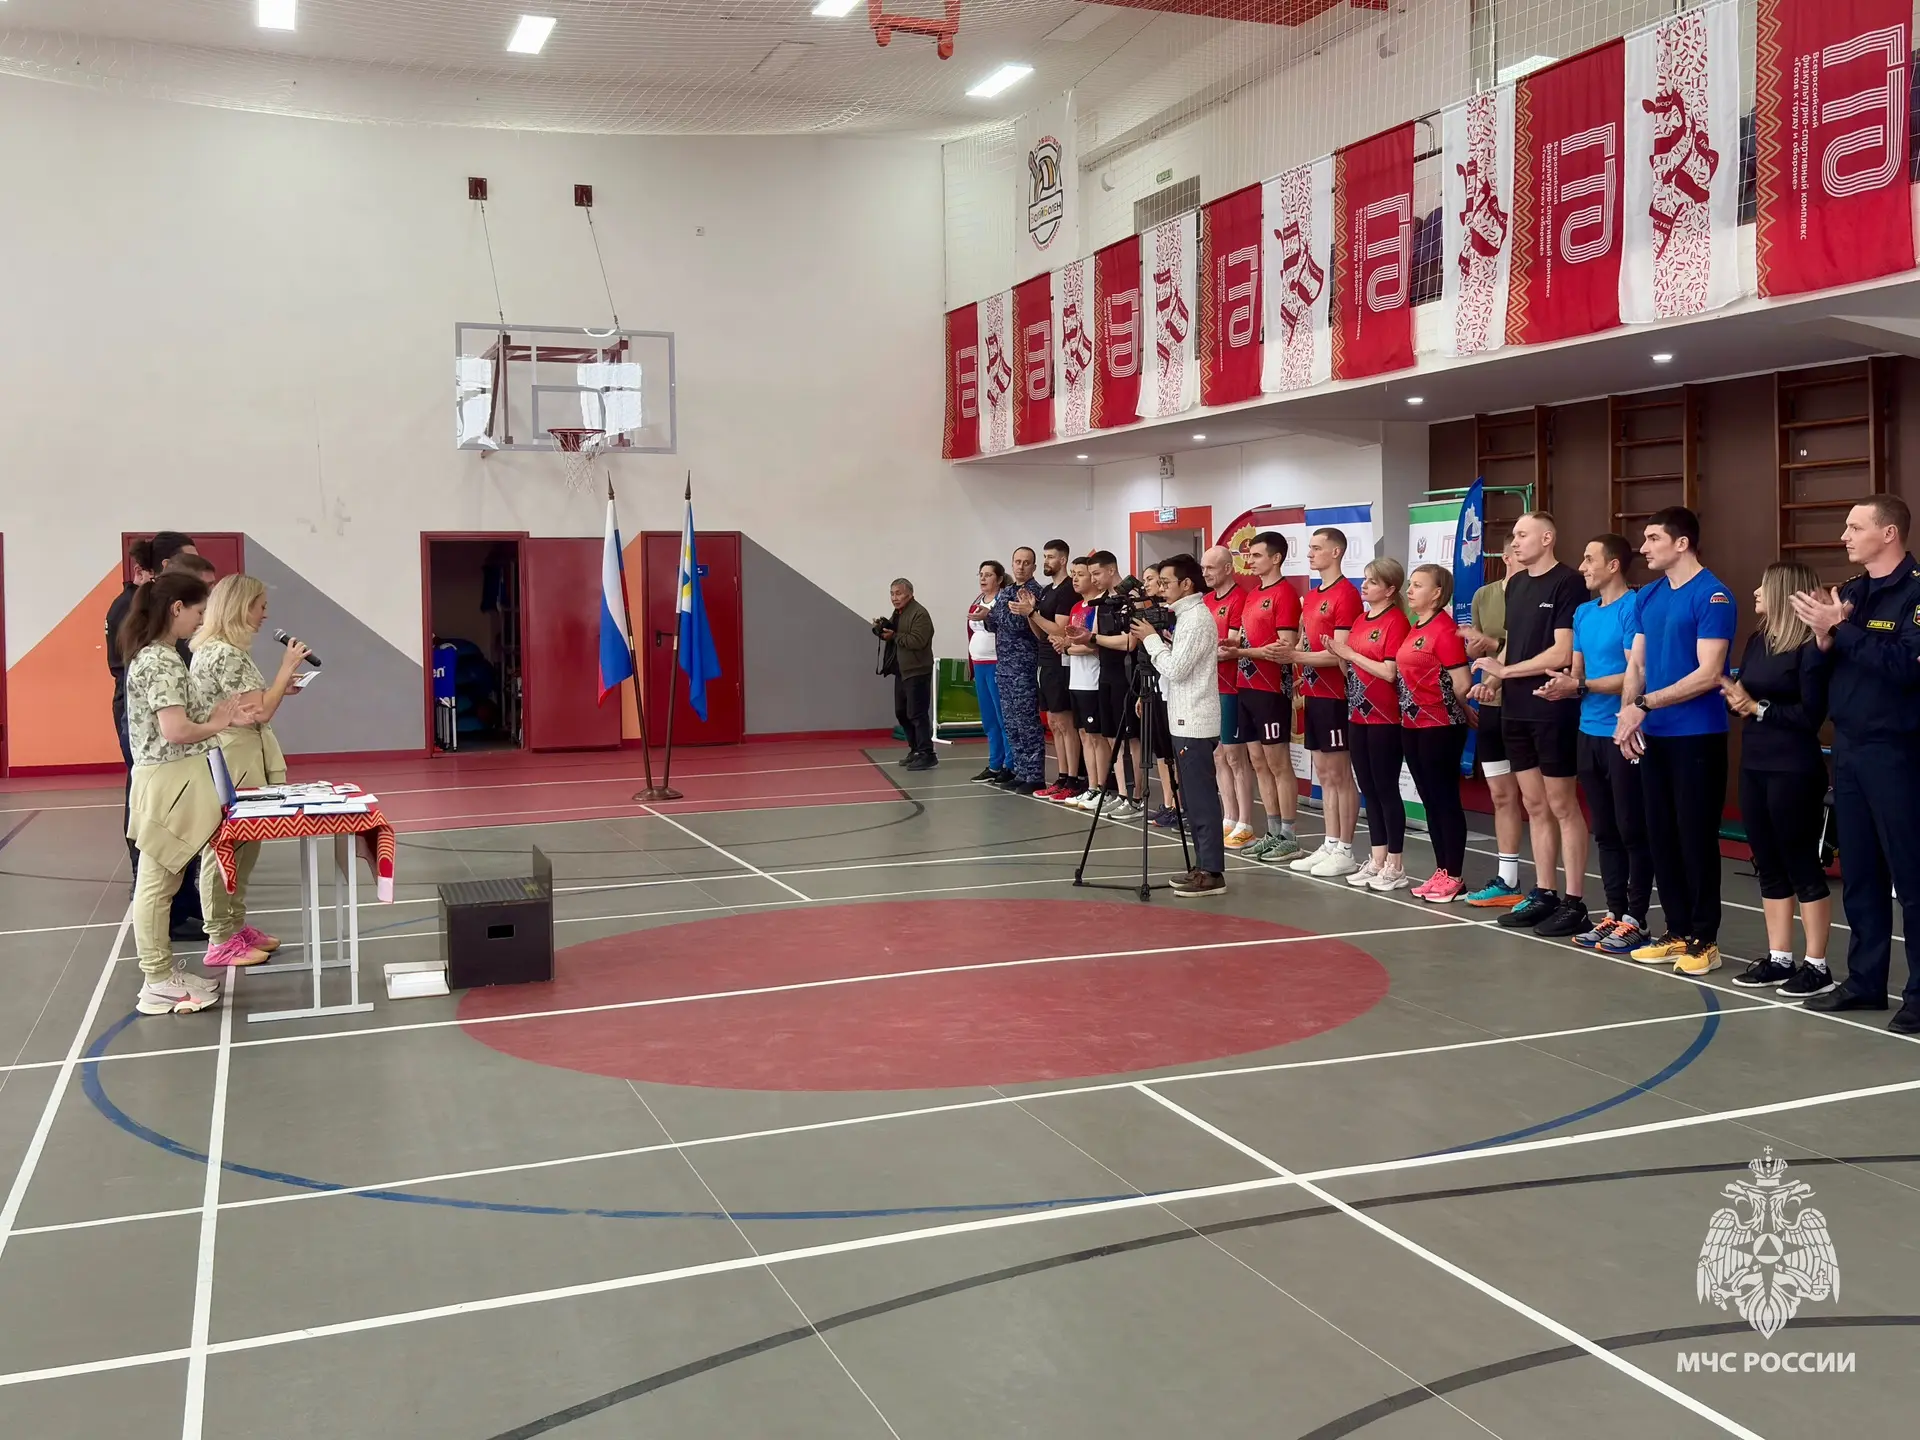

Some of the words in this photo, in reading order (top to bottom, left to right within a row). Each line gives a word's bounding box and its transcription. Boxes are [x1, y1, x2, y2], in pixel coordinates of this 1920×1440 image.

[1791, 100, 1799, 130] труду
[1793, 57, 1801, 90] «Готов
[1811, 52, 1820, 128] Всероссийский
[1822, 23, 1905, 198] ГТО
[1801, 54, 1811, 190] физкультурно-спортивный
[1545, 142, 1553, 256] физкультурно-спортивный
[1560, 122, 1617, 264] ГТО
[1791, 141, 1801, 190] обороне»
[1366, 193, 1410, 312] ГТО
[1799, 192, 1808, 240] комплекс
[1111, 288, 1139, 378] ГТО
[1229, 244, 1258, 348] ГТО
[1264, 722, 1280, 740] 10
[1330, 729, 1344, 747] 11
